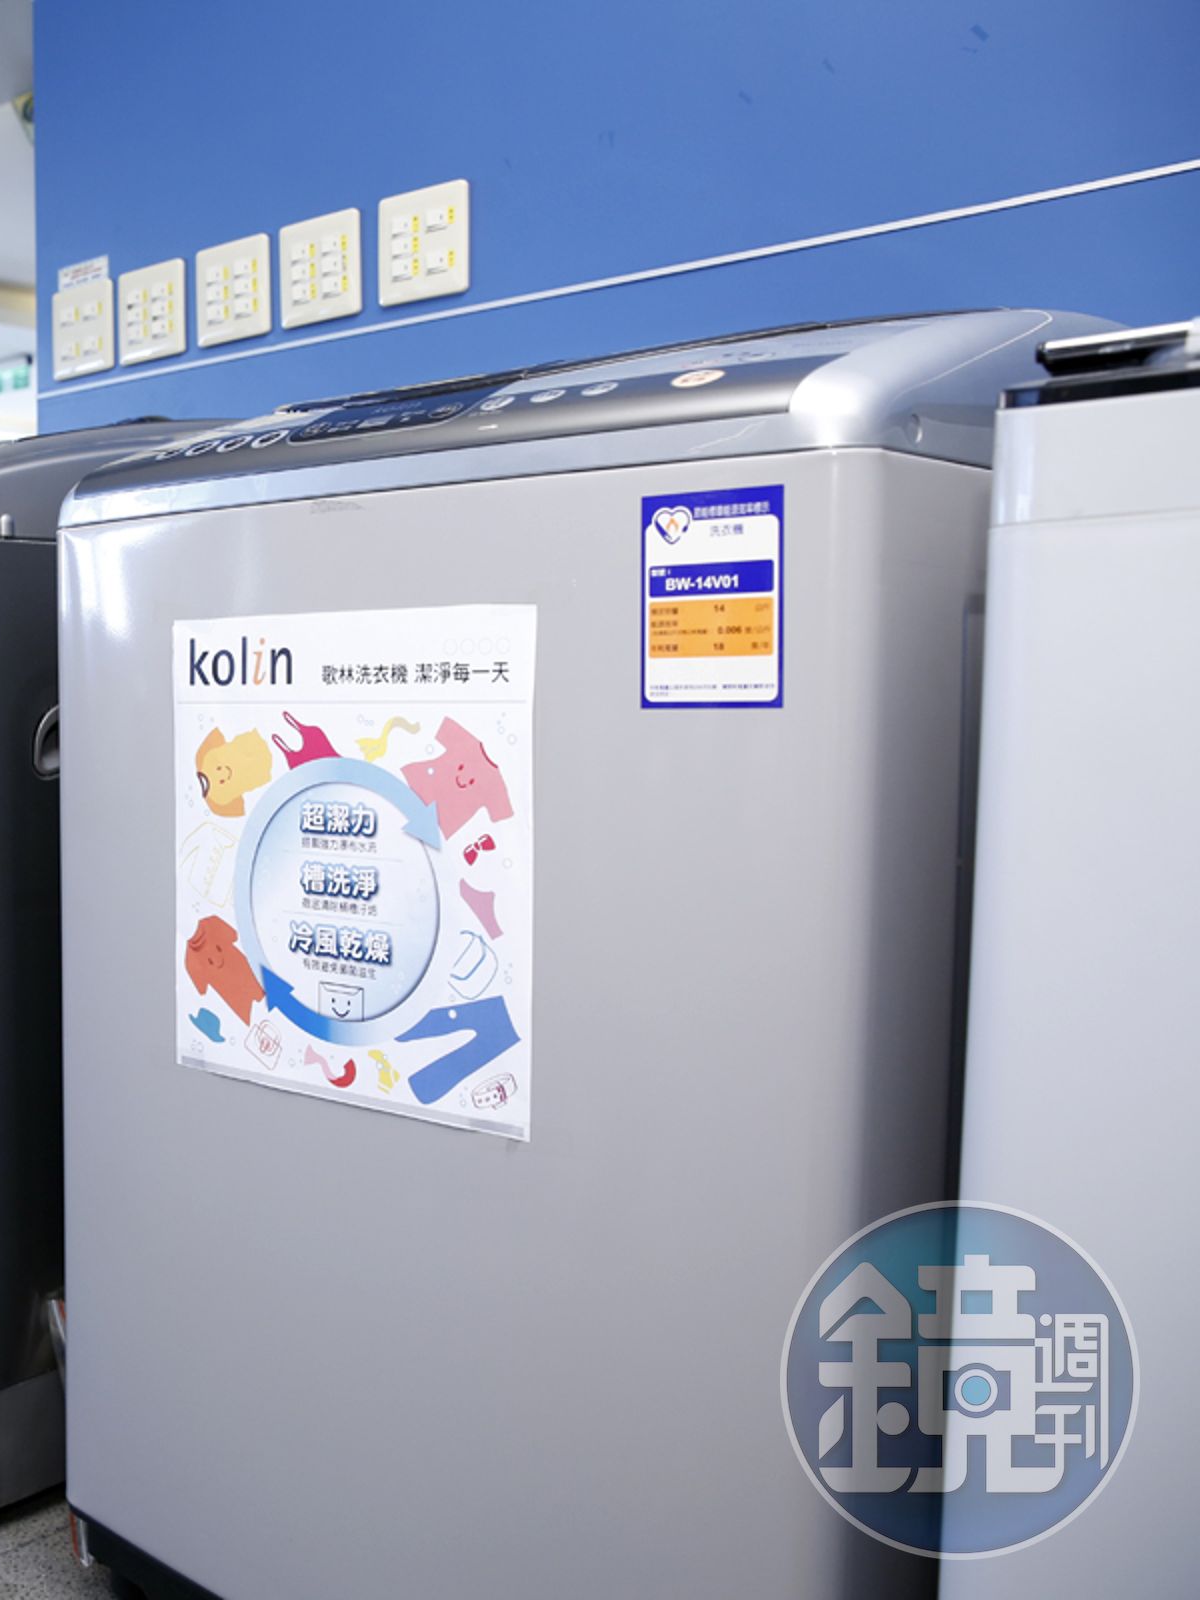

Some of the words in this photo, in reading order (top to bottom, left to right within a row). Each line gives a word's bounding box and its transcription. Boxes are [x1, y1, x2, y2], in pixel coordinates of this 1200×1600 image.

[665, 574, 739, 591] BW-14V01
[189, 636, 293, 686] kolin
[321, 664, 409, 685] 歌林洗衣機
[414, 661, 510, 684] 潔淨每一天
[300, 801, 378, 837] 超潔力
[300, 862, 379, 899] 槽洗淨
[289, 920, 392, 967] 冷風乾燥
